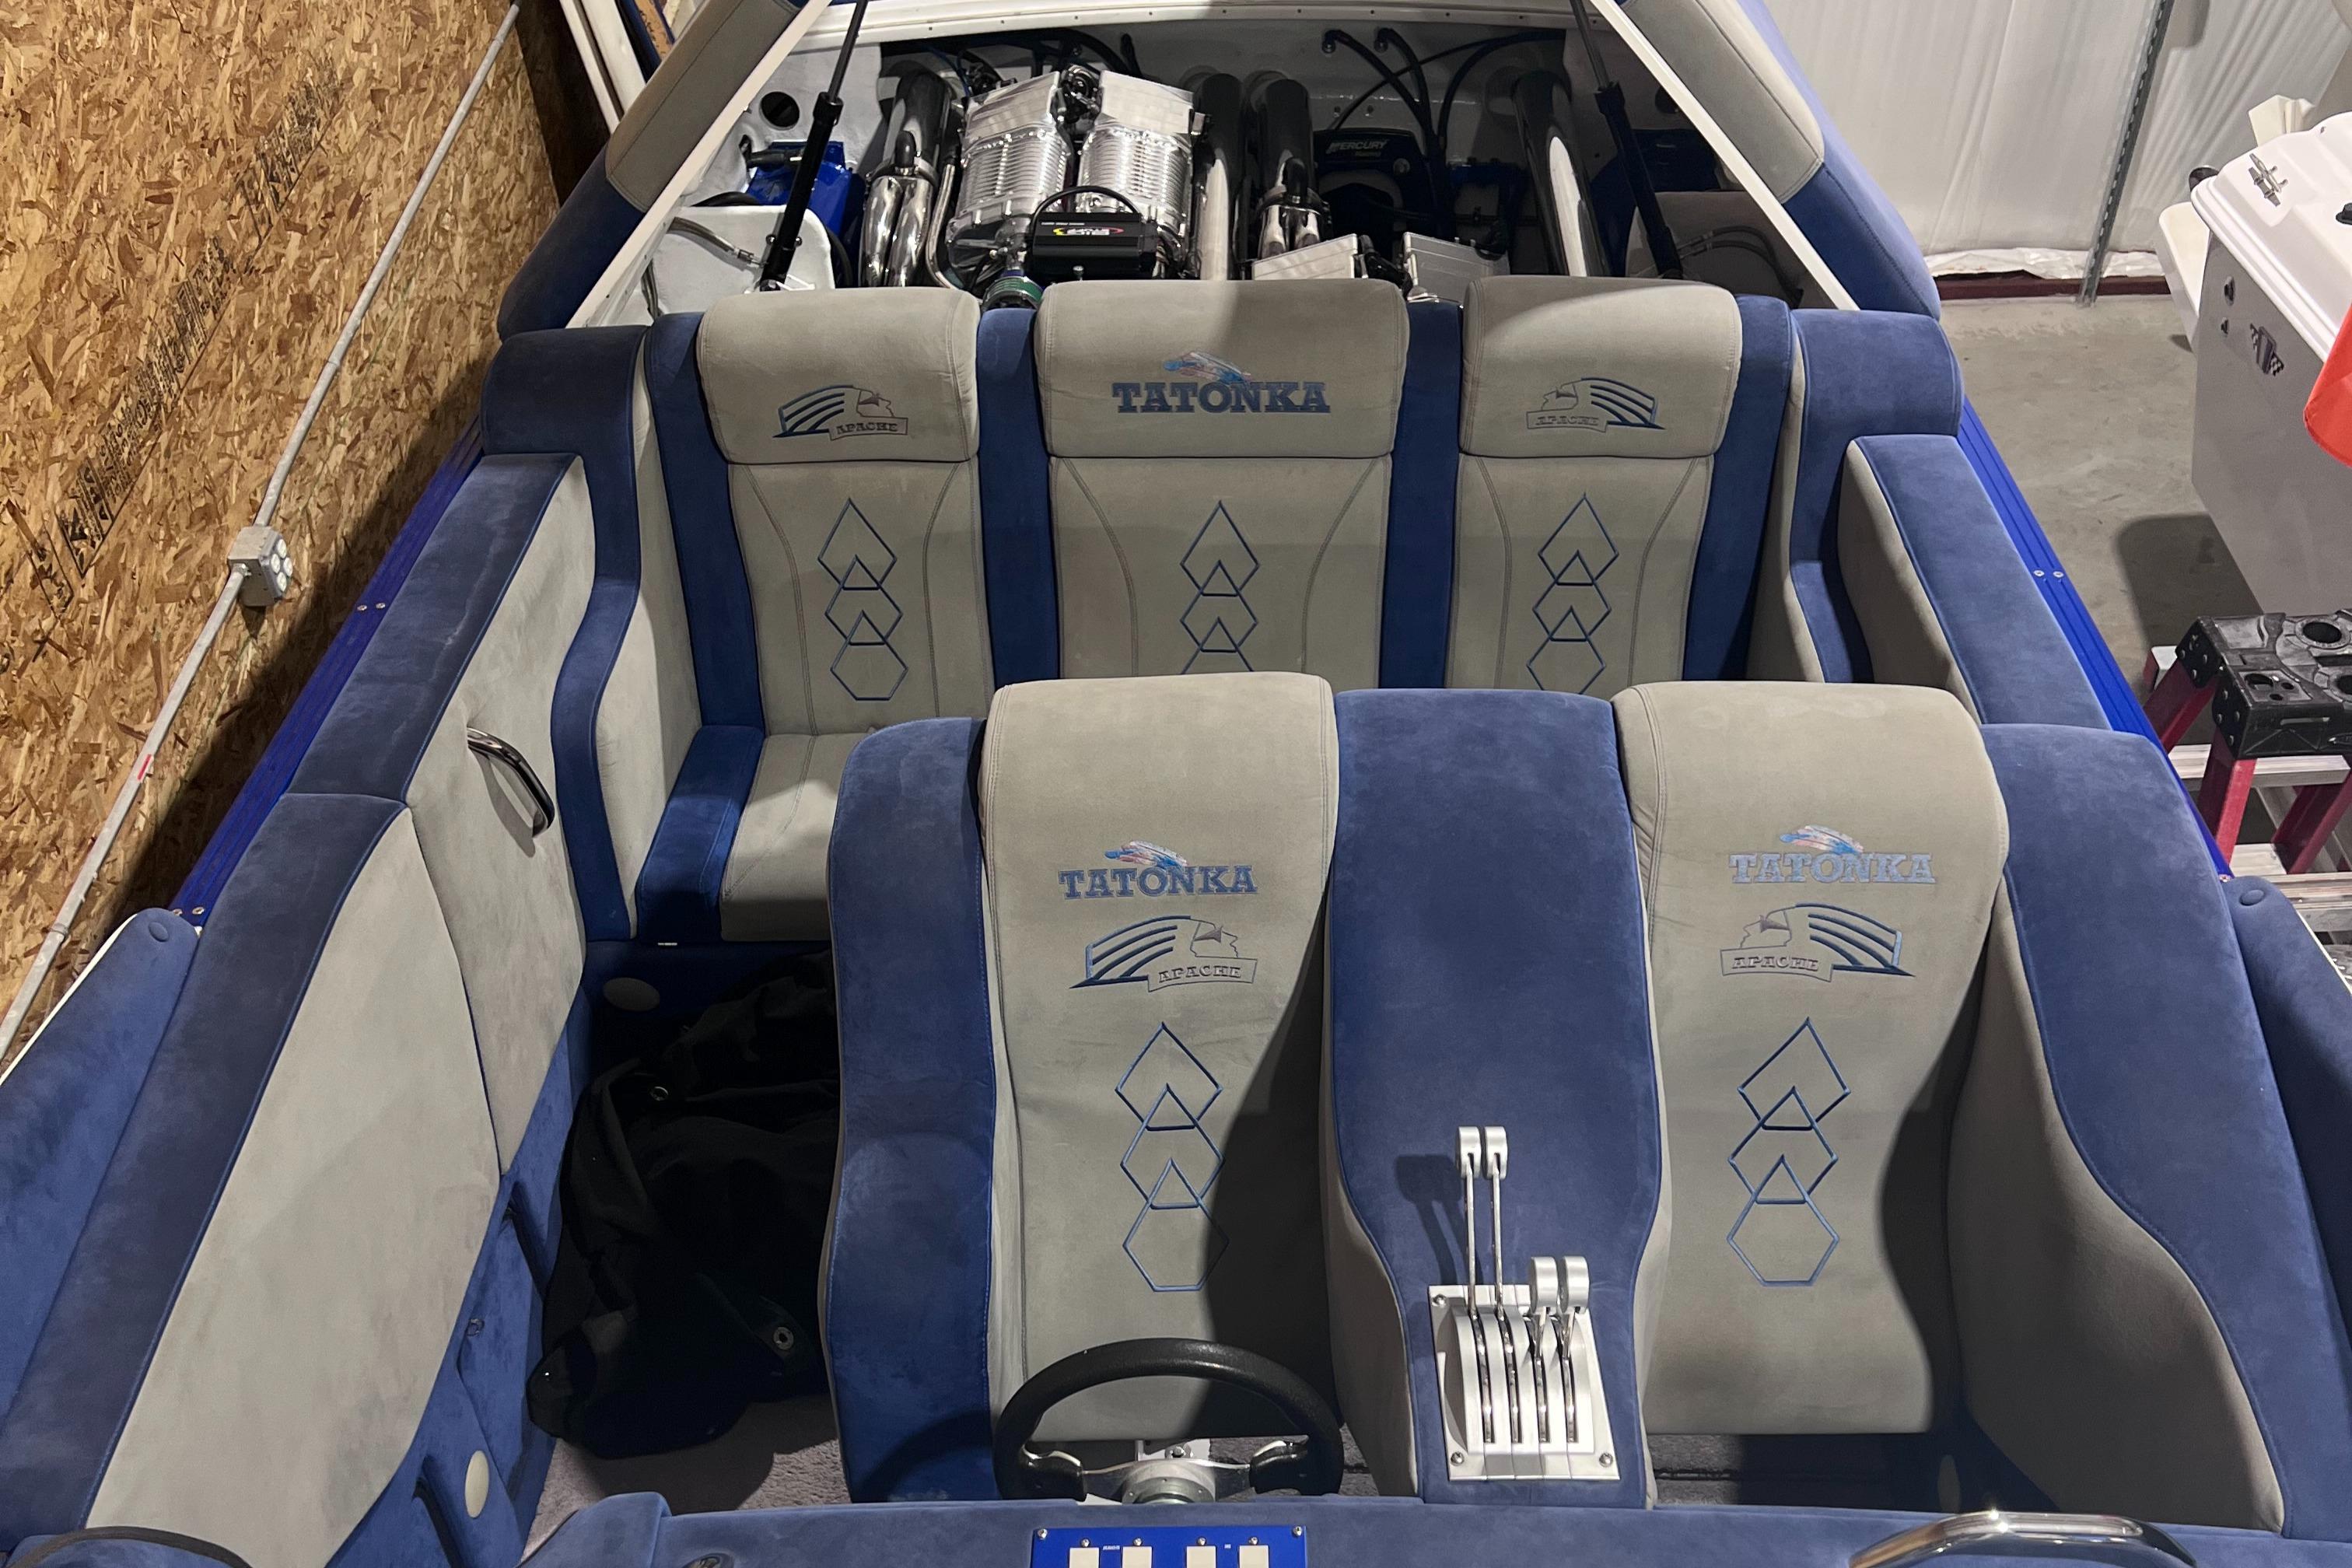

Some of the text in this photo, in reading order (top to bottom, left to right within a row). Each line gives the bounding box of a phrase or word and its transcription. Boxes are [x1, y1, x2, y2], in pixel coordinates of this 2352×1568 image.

[1325, 139, 1388, 155] MERCURY
[1111, 381, 1331, 413] TATONKA
[836, 422, 898, 435] APACHE
[1729, 853, 1936, 884] TATONKA
[1058, 865, 1258, 900] TATONKA
[1158, 964, 1241, 983] APACHE
[1732, 957, 1818, 971] APACHE
